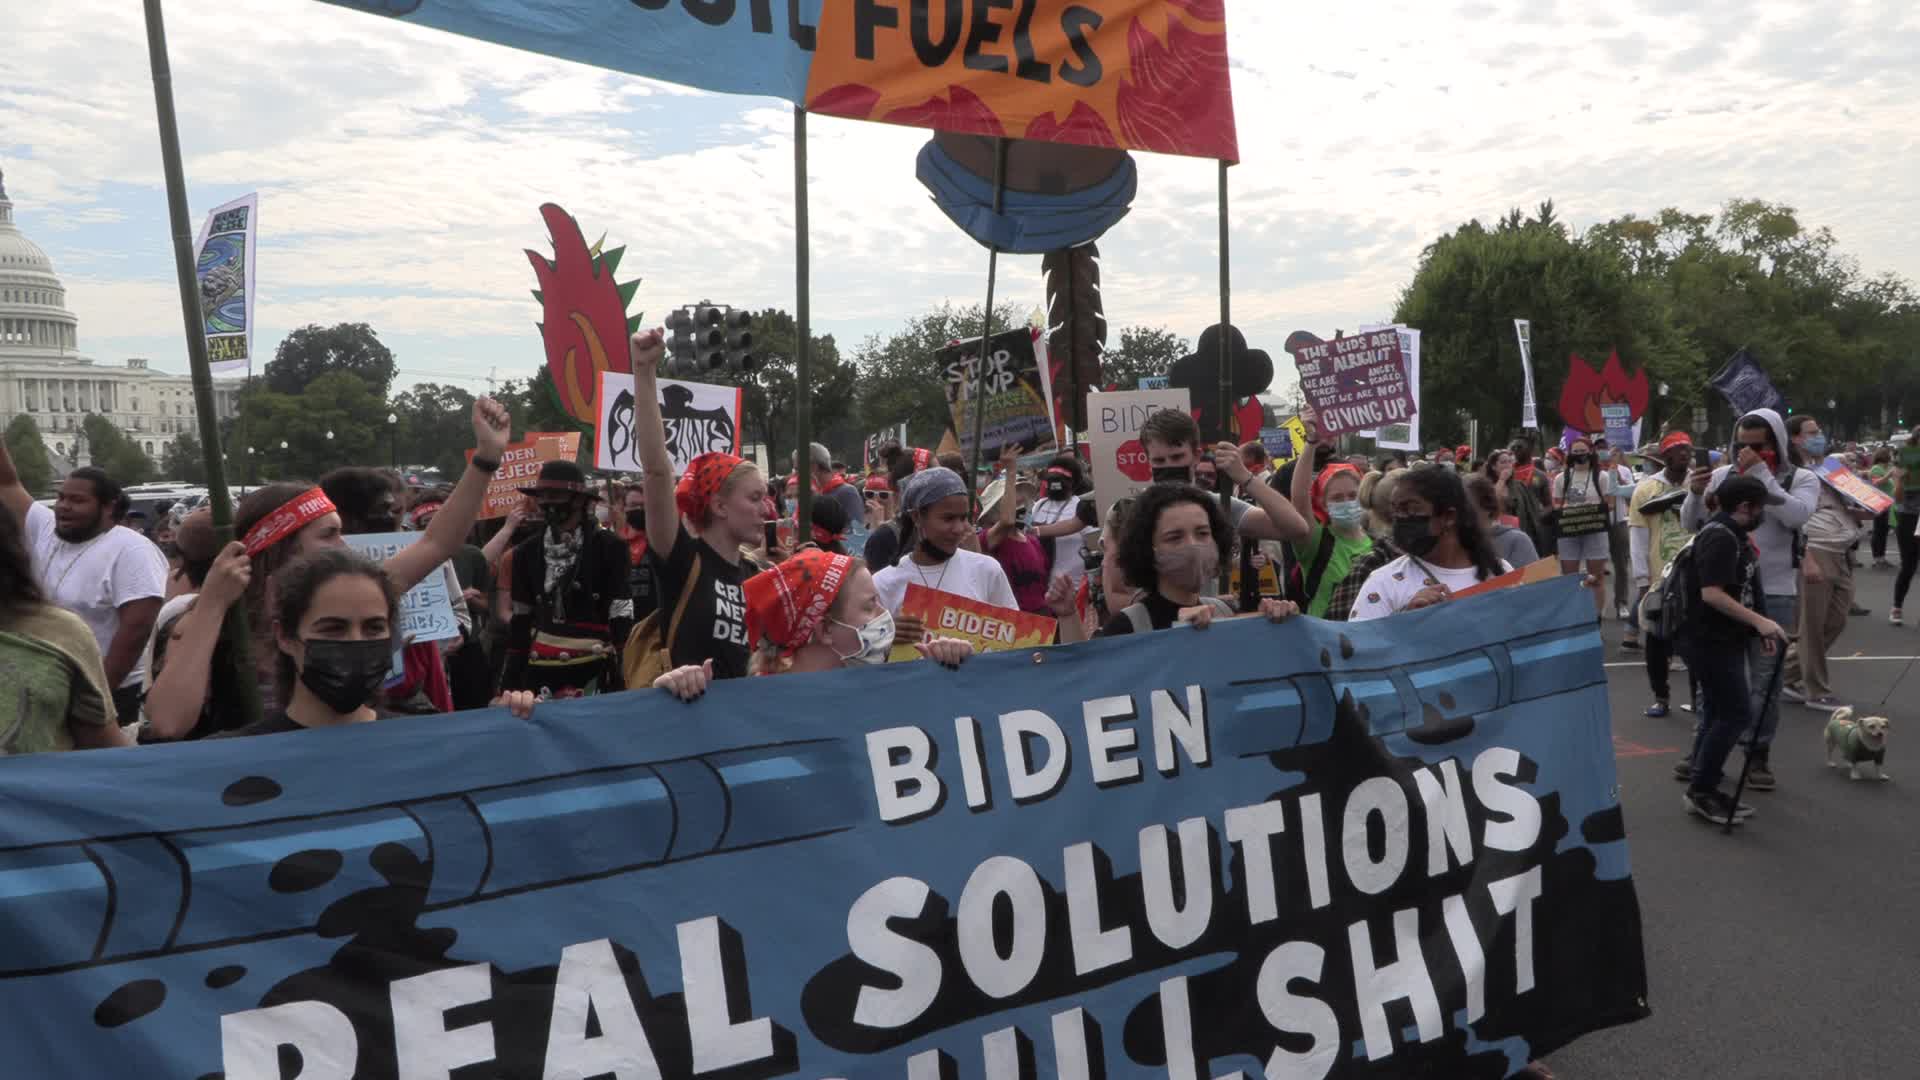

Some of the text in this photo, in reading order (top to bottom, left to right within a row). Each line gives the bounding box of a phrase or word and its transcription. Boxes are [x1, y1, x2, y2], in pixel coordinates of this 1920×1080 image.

[854, 0, 1104, 87] FUELS
[1299, 332, 1397, 361] THE KIDS ARE
[946, 350, 1011, 382] STOP
[1299, 360, 1320, 375] NOT
[1304, 375, 1338, 389] WE ARE
[1320, 397, 1336, 407] BUT
[1356, 389, 1374, 400] ARE
[1377, 382, 1404, 397] NOT
[1322, 398, 1407, 432] GIVING UP
[500, 447, 536, 463] DEN
[1118, 452, 1147, 465] STO
[491, 461, 545, 481] EJECT
[712, 619, 750, 647] DEA
[942, 606, 1016, 644] BIDEN
[865, 684, 1209, 823] BIDEN
[847, 747, 1543, 1029] SOLUTIONS
[818, 865, 1543, 1080] LSHIT
